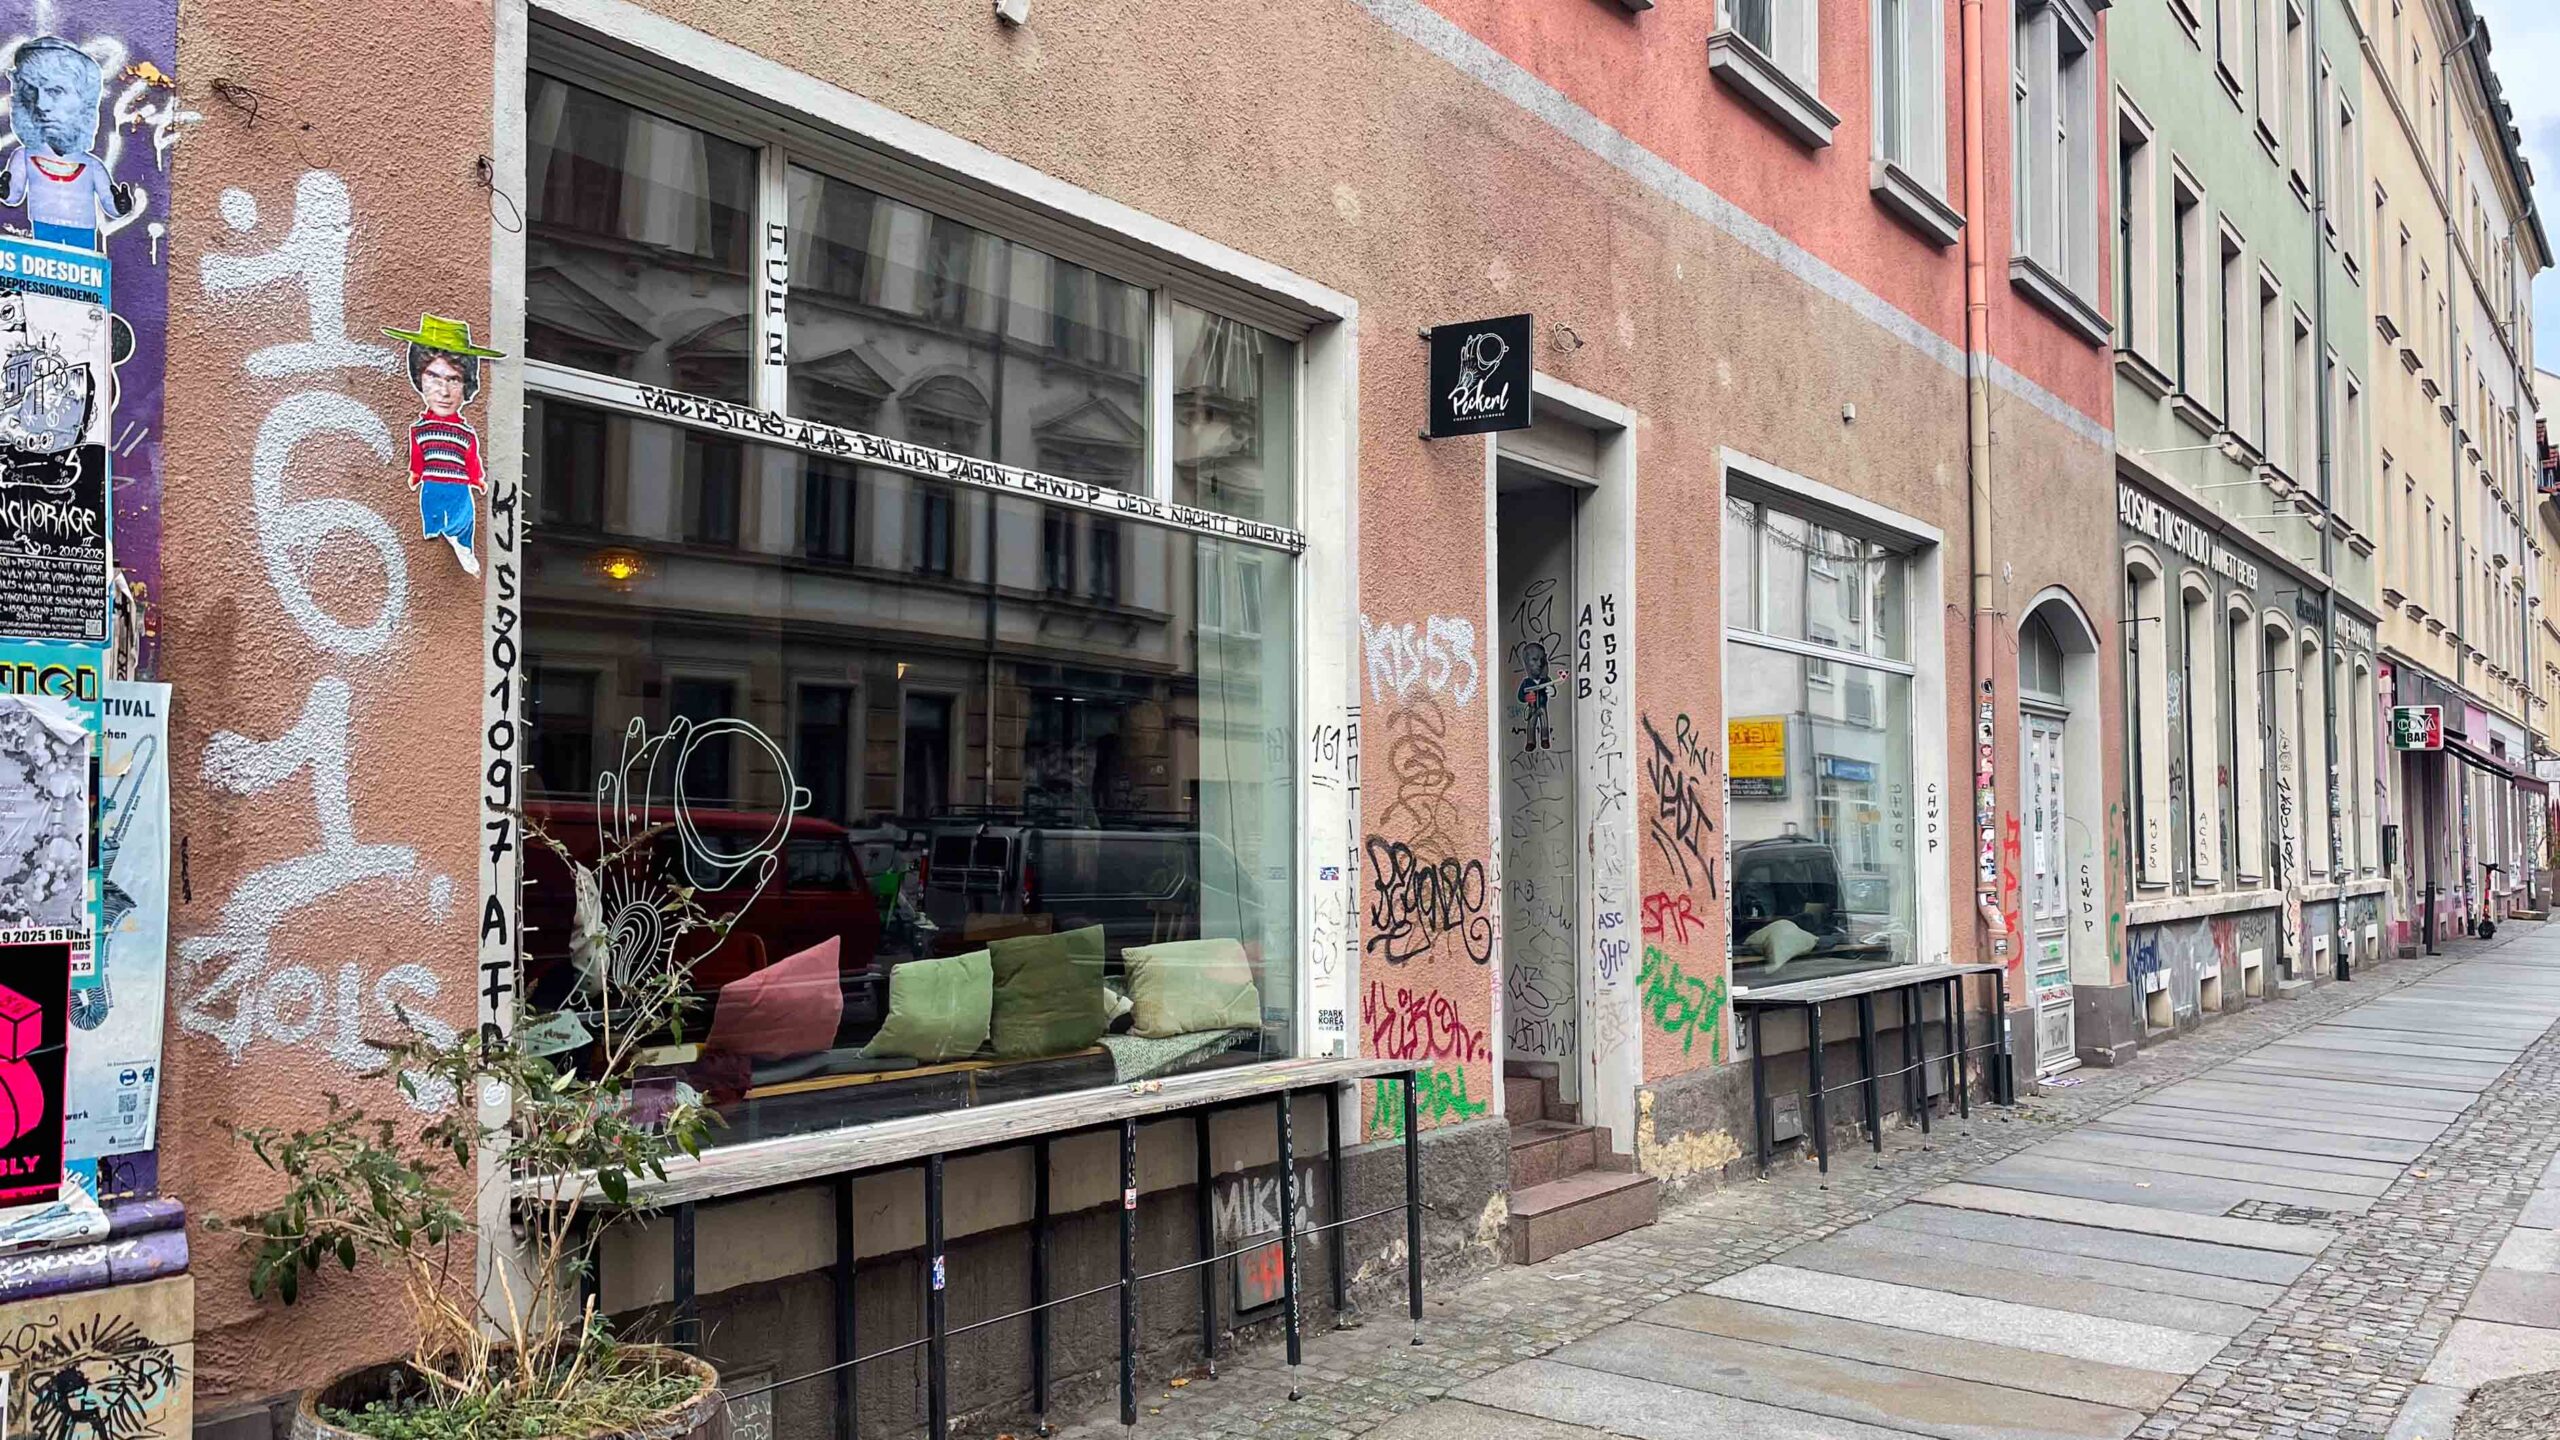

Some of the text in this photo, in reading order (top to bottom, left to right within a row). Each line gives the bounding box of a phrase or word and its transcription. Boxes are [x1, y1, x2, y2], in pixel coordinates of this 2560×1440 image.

[22, 255, 102, 288] DRESDEN
[1448, 379, 1509, 415] Pickerl
[1022, 473, 1100, 506] CHWDP
[1117, 492, 1164, 518] JEDE
[2119, 483, 2210, 566] KOSMETIKSTUDIO
[1578, 602, 1592, 700] ACAB
[1312, 725, 1341, 770] 161
[2406, 732, 2428, 743] BAR
[1926, 783, 1939, 853] CHWDP
[2080, 864, 2094, 932] CHWDP
[49, 929, 63, 940] 16
[1318, 1009, 1343, 1017] SPARK
[1318, 1016, 1344, 1025] KOREA
